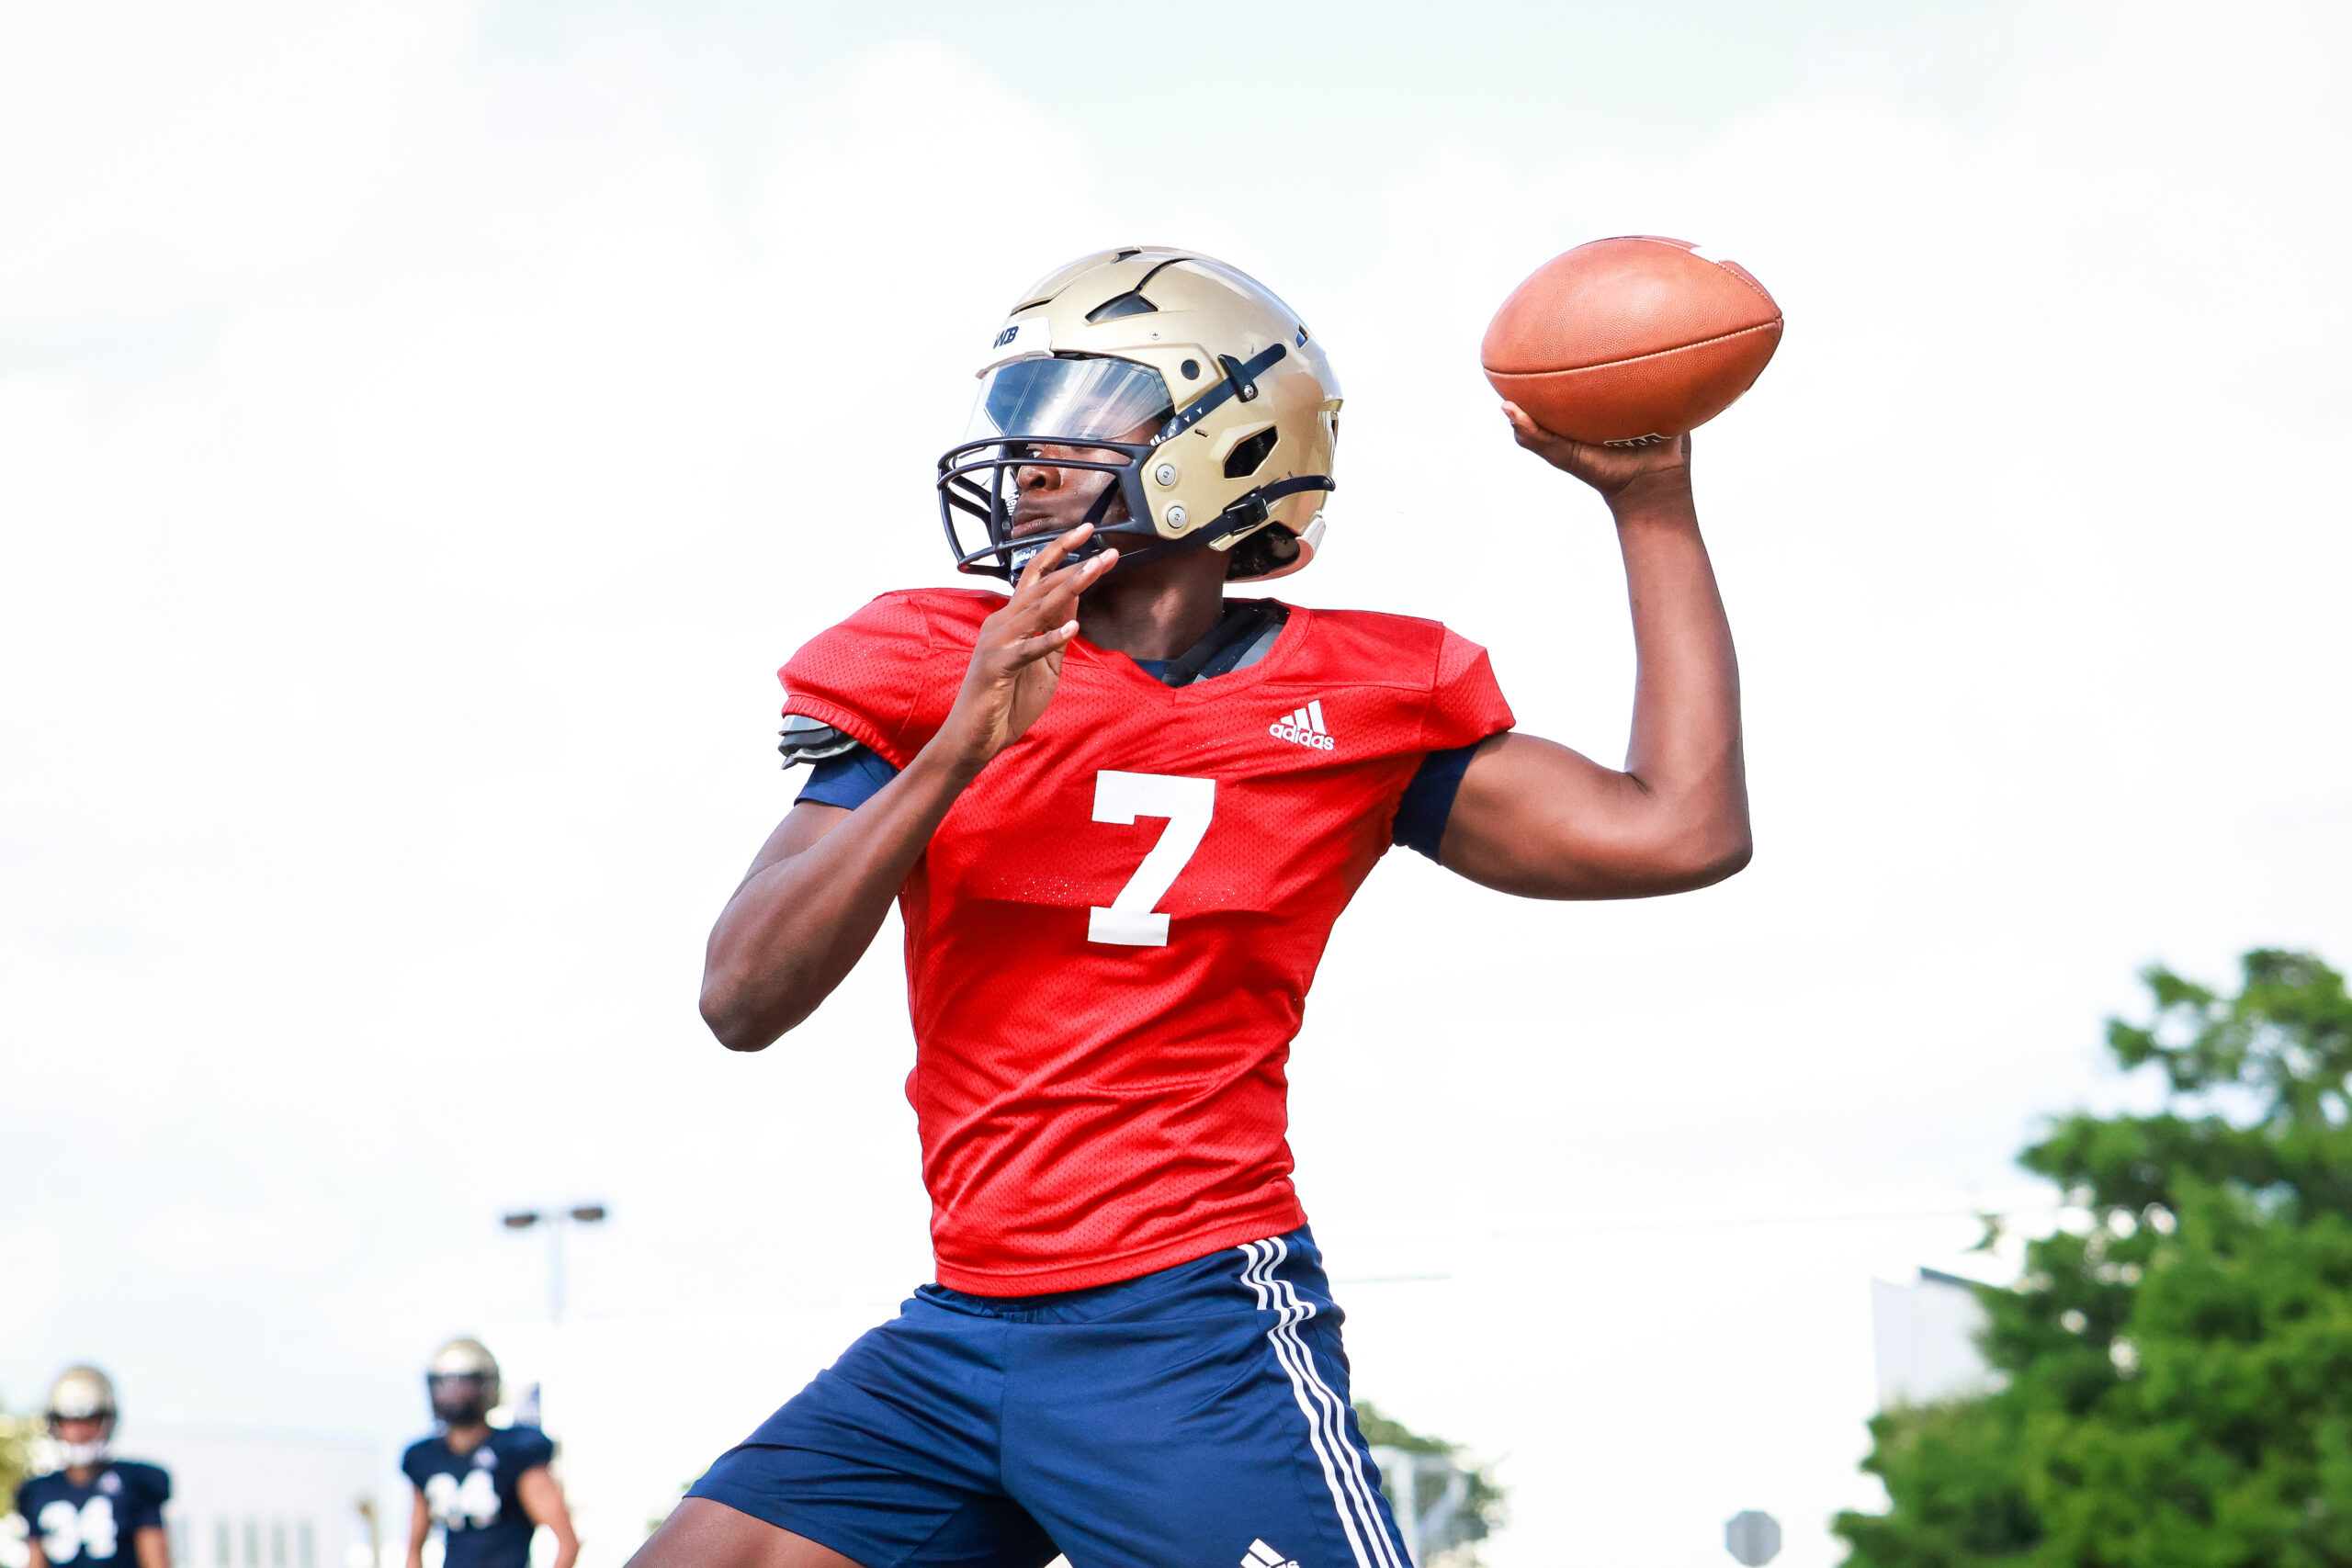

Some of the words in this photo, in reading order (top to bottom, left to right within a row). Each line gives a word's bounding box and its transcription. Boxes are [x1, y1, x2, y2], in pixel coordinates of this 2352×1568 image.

[1269, 724, 1335, 750] adidas
[1087, 770, 1216, 947] 7
[38, 1495, 119, 1564] 34
